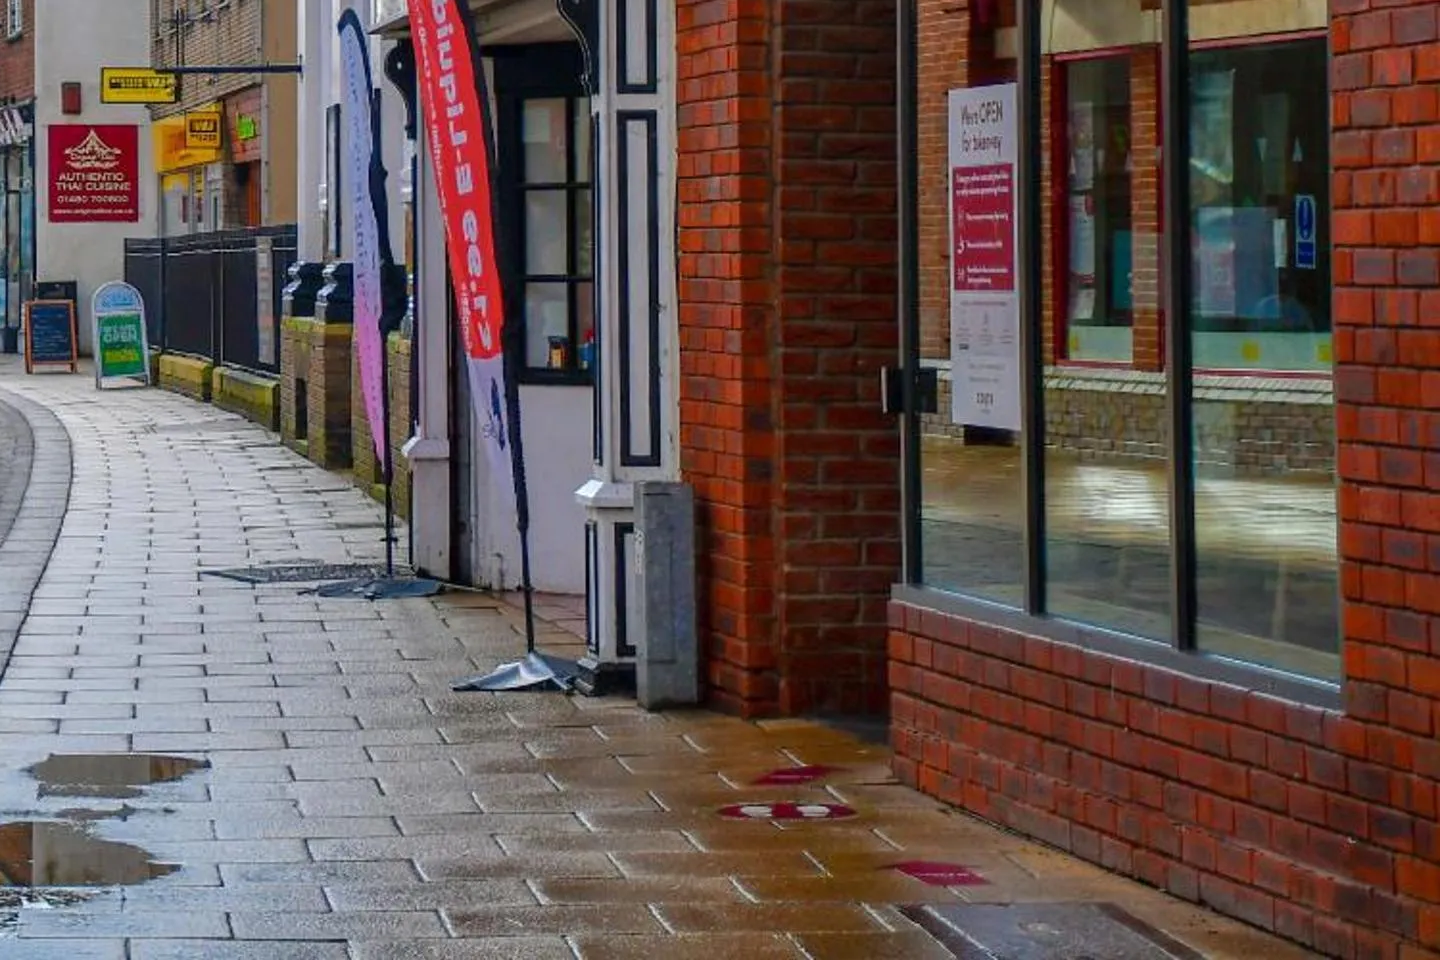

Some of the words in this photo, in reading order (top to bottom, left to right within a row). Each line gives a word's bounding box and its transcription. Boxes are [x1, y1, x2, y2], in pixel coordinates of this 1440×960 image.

[59, 172, 124, 181] AUTHENTIC
[56, 182, 81, 191] THAI
[85, 182, 131, 191] CUISINE
